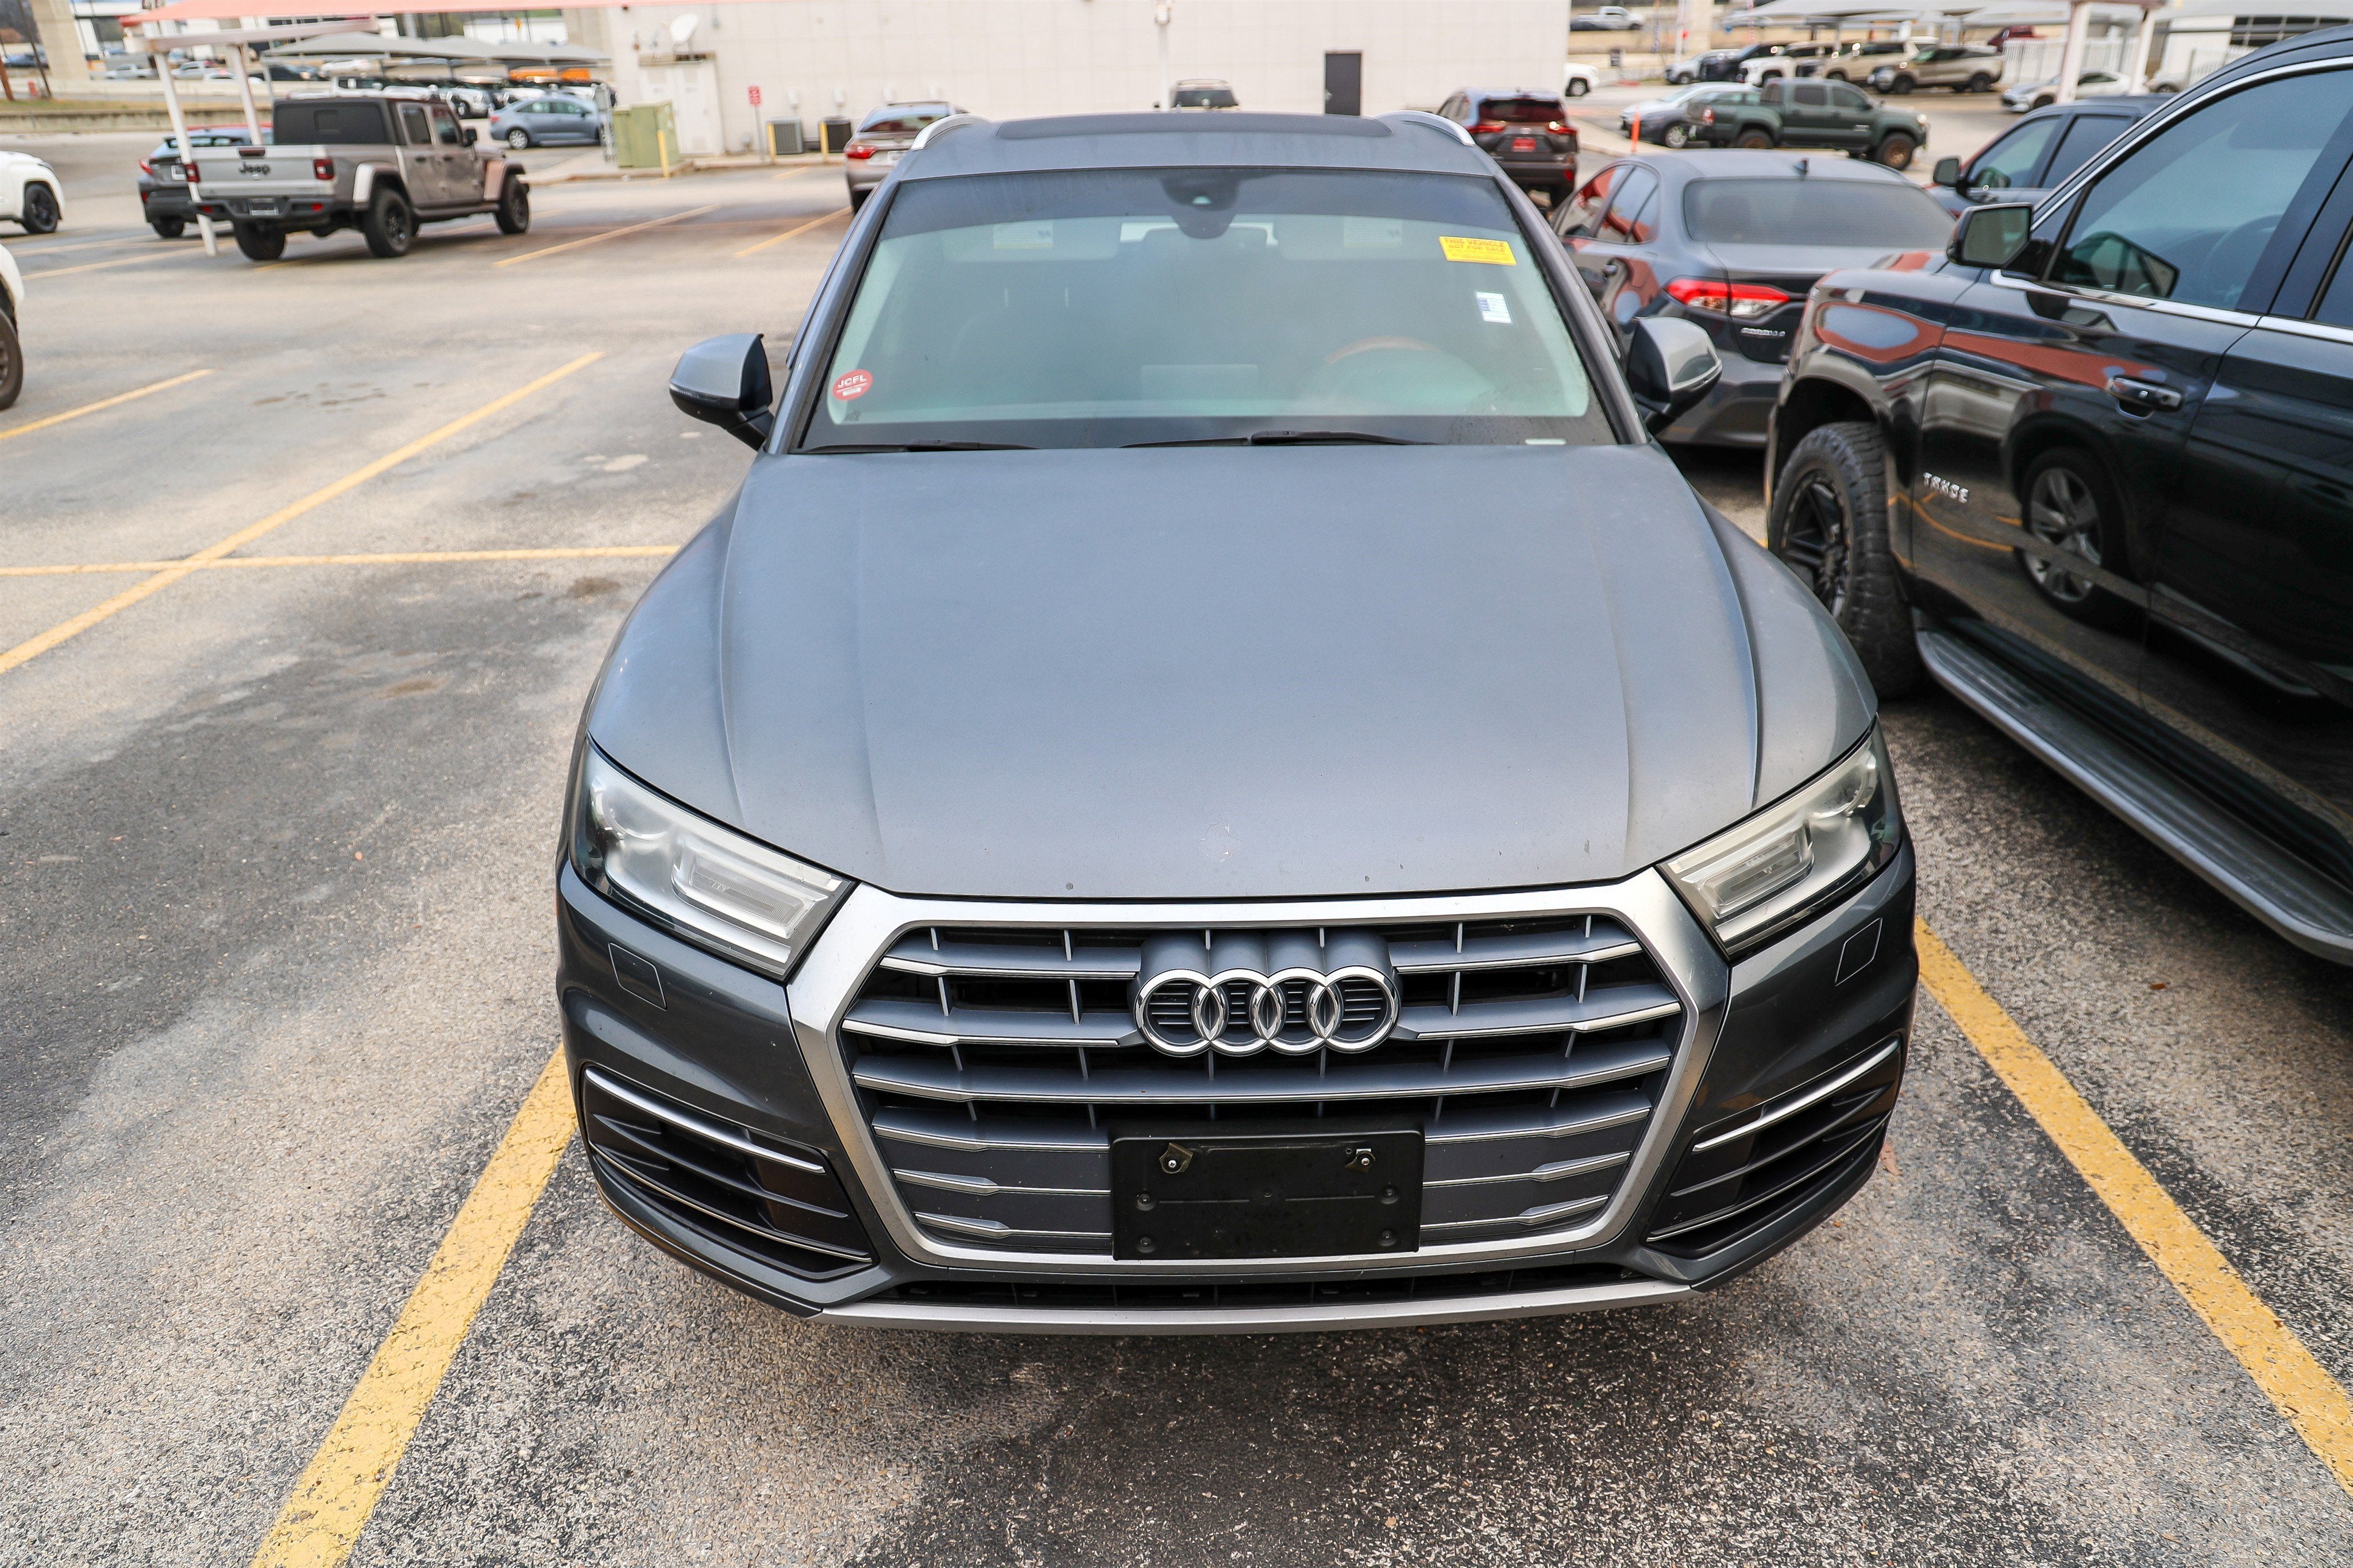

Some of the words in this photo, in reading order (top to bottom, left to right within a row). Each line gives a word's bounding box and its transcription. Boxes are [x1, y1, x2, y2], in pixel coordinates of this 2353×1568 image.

[238, 161, 271, 175] Jeep
[1466, 239, 1506, 248] VEHICLE
[837, 374, 867, 388] JCFL
[1922, 472, 1969, 503] TAHOE
